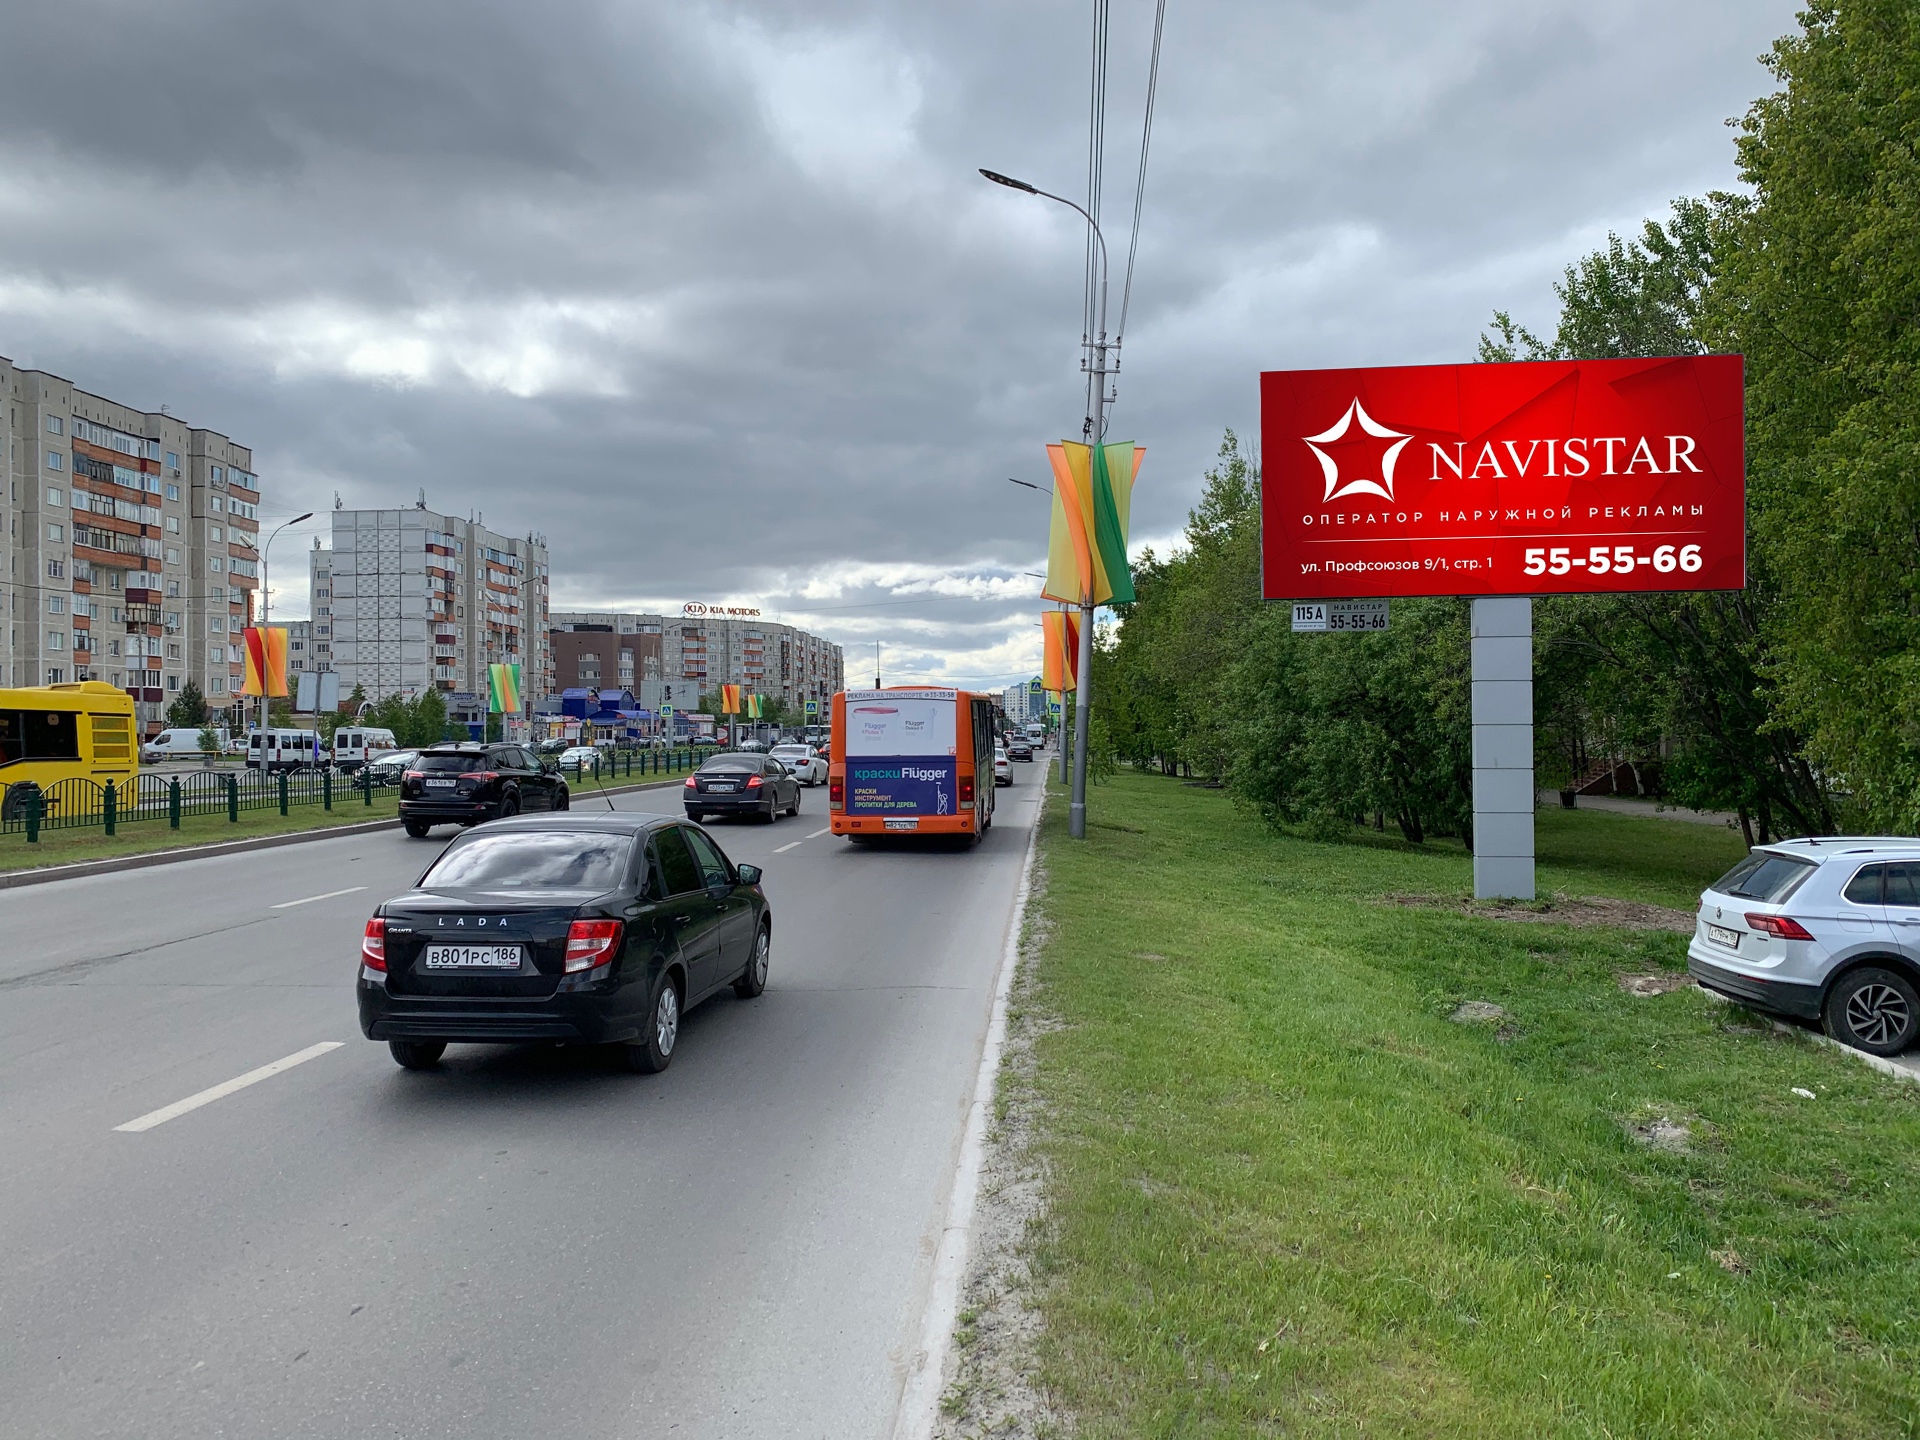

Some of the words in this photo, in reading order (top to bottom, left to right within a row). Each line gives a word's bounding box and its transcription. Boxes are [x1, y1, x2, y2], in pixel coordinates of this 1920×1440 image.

[1426, 435, 1703, 480] NAVISTAR
[1303, 512, 1423, 525] ОПЕРАТОР
[1440, 506, 1571, 520] НАРУЖНОЙ
[1589, 505, 1703, 518] РЕКЛАМЫ
[1301, 562, 1321, 574] ул.
[1325, 560, 1420, 572] Профсоюзов
[1424, 558, 1449, 571] 9/1,
[1454, 558, 1482, 570] стр.
[1487, 557, 1493, 568] 1
[1523, 544, 1703, 576] 55-55-66
[727, 608, 760, 616] MOTORS
[1296, 606, 1313, 620] 115
[1331, 614, 1385, 628] 55-55-66
[855, 770, 900, 780] краски
[902, 768, 947, 780] Flügger
[883, 801, 895, 809] ДЛЯ
[896, 801, 917, 809] ДЕРЕВА
[438, 918, 507, 926] LADA
[431, 948, 490, 964] В801РС
[494, 948, 516, 960] 186
